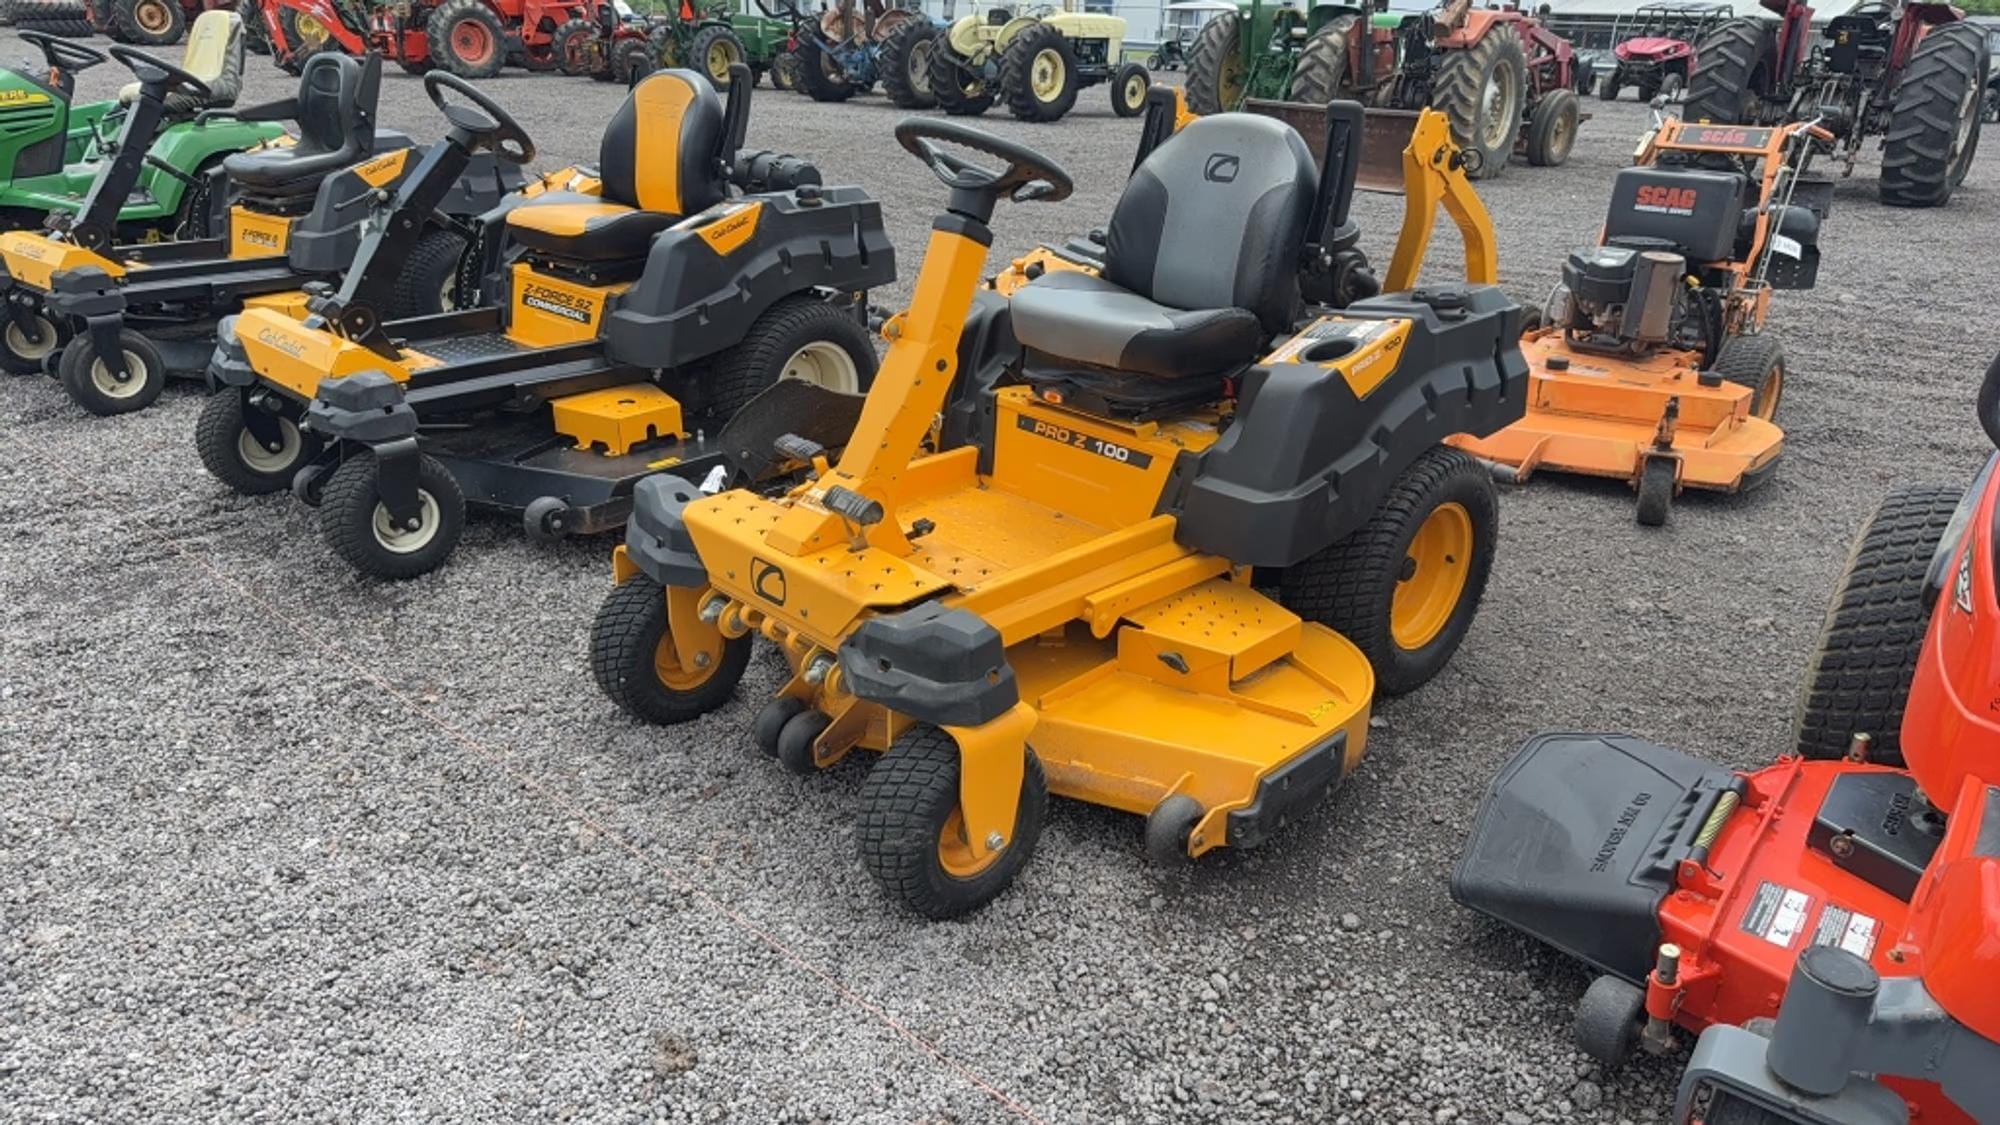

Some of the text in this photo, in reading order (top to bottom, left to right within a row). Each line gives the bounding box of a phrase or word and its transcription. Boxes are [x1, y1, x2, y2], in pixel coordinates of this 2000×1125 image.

[1635, 185, 1697, 208] SCAG
[524, 283, 575, 306] Z-FORCE
[526, 296, 586, 322] COMMERCIAL
[1034, 421, 1130, 462] PRO Z 100
